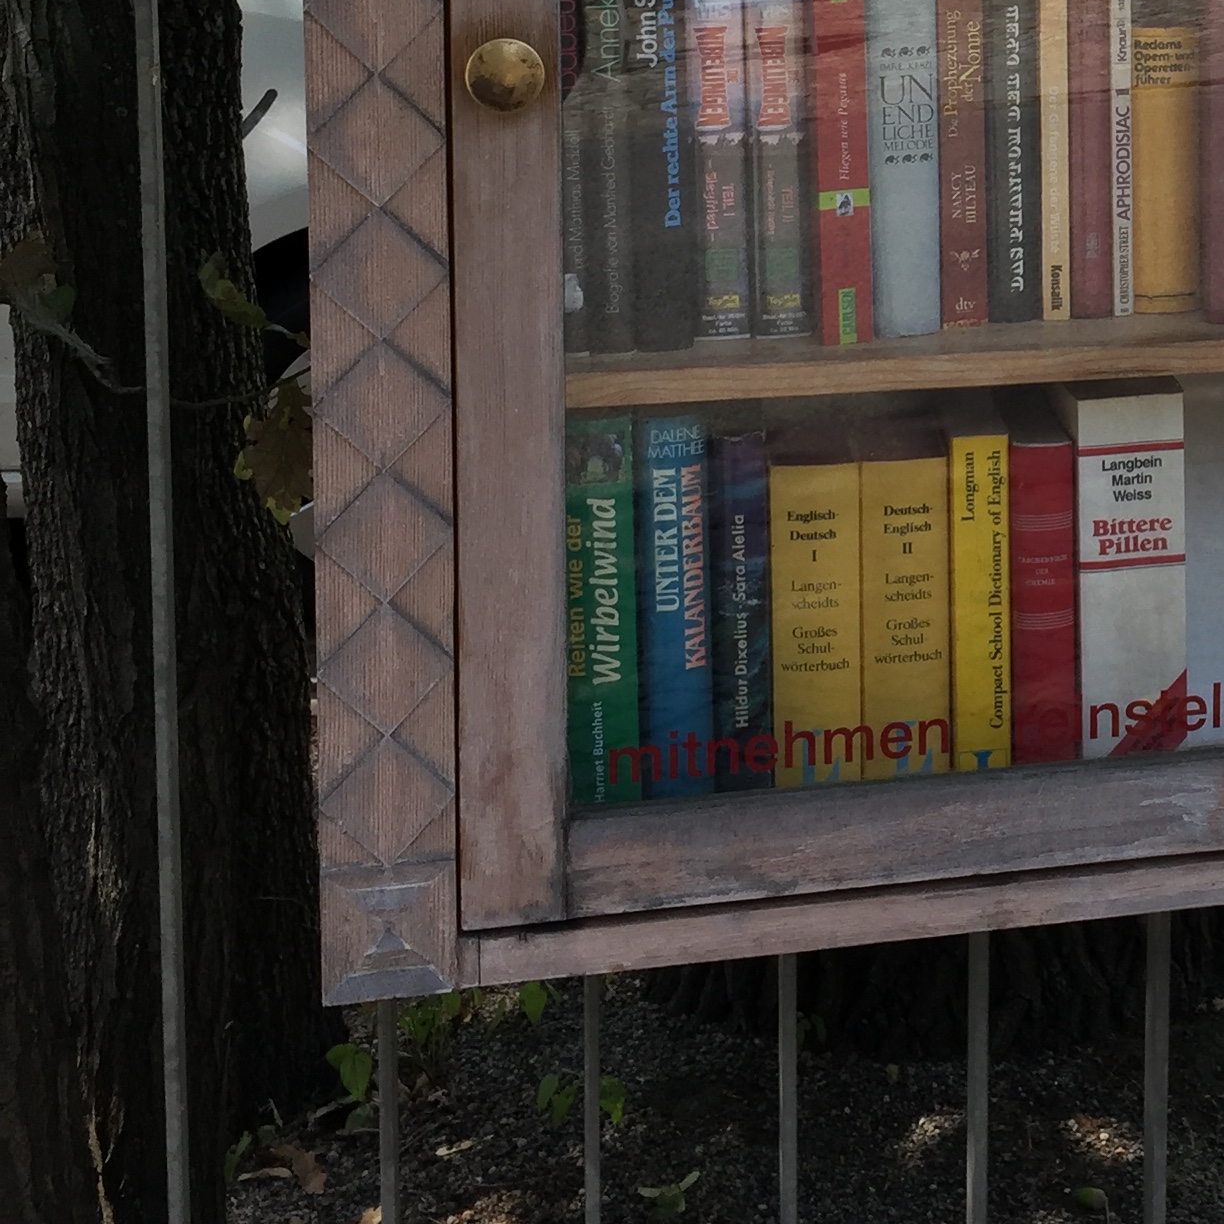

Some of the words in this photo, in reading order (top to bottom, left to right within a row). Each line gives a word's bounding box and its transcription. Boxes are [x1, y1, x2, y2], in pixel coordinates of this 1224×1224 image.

[636, 12, 657, 68] John
[659, 34, 677, 64] der
[960, 20, 983, 82] Nonne
[943, 9, 962, 118] Prophezeiung
[879, 74, 934, 106] UN
[961, 80, 974, 103] der
[1135, 74, 1171, 87] führer
[882, 104, 935, 125] END
[882, 124, 935, 141] LICHE
[884, 139, 935, 152] MELODIE
[662, 117, 680, 181] rechte
[1116, 105, 1131, 221] APHRODISIAC
[664, 187, 682, 228] Der
[951, 172, 962, 220] NANCY
[965, 164, 977, 224] BILYEAU
[1119, 226, 1130, 252] STREET
[1050, 265, 1064, 311] Konsalik
[1119, 253, 1129, 304] CHRISTOPHER
[955, 297, 977, 314] dtv
[647, 438, 705, 461] MATTHEE
[650, 424, 702, 445] DALENE
[986, 449, 1007, 509] English
[1102, 455, 1163, 473] Langbein
[1112, 472, 1153, 487] Martin
[652, 468, 679, 523] DEM
[961, 450, 980, 523] Longman
[1112, 489, 1152, 503] Weiss
[786, 510, 840, 526] Englisch-
[883, 503, 934, 518] Deutsch-
[566, 515, 583, 553] der
[730, 514, 746, 563] Alelia
[790, 529, 838, 543] Deutsch
[883, 521, 933, 536] Englisch
[1093, 518, 1174, 538] Bittere
[902, 542, 913, 555] II
[1098, 534, 1169, 556] Pillen
[568, 559, 585, 599] wie
[654, 526, 680, 613] UNTER
[681, 463, 708, 671] KALANDERBAUM
[885, 570, 935, 586] Langen-
[987, 530, 1007, 610] Dictionary
[586, 497, 622, 686] Wirbelwind
[731, 565, 747, 603] Sara
[791, 578, 843, 595] Langen-
[884, 588, 934, 604] scheidts
[791, 596, 840, 611] scheidts
[792, 626, 838, 640] Großes
[886, 617, 931, 632] Großes
[987, 614, 1004, 661] School
[567, 607, 587, 678] Reiten
[732, 611, 749, 677] Dixelius
[797, 641, 836, 655] Schul-
[874, 648, 944, 666] wörterbuch
[781, 658, 851, 674] wörterbuch
[734, 679, 750, 729] Hildur
[988, 663, 1008, 730] Compact
[591, 701, 604, 756] Buchheit
[607, 718, 950, 785] mitnehmen
[592, 757, 605, 804] Harriet
